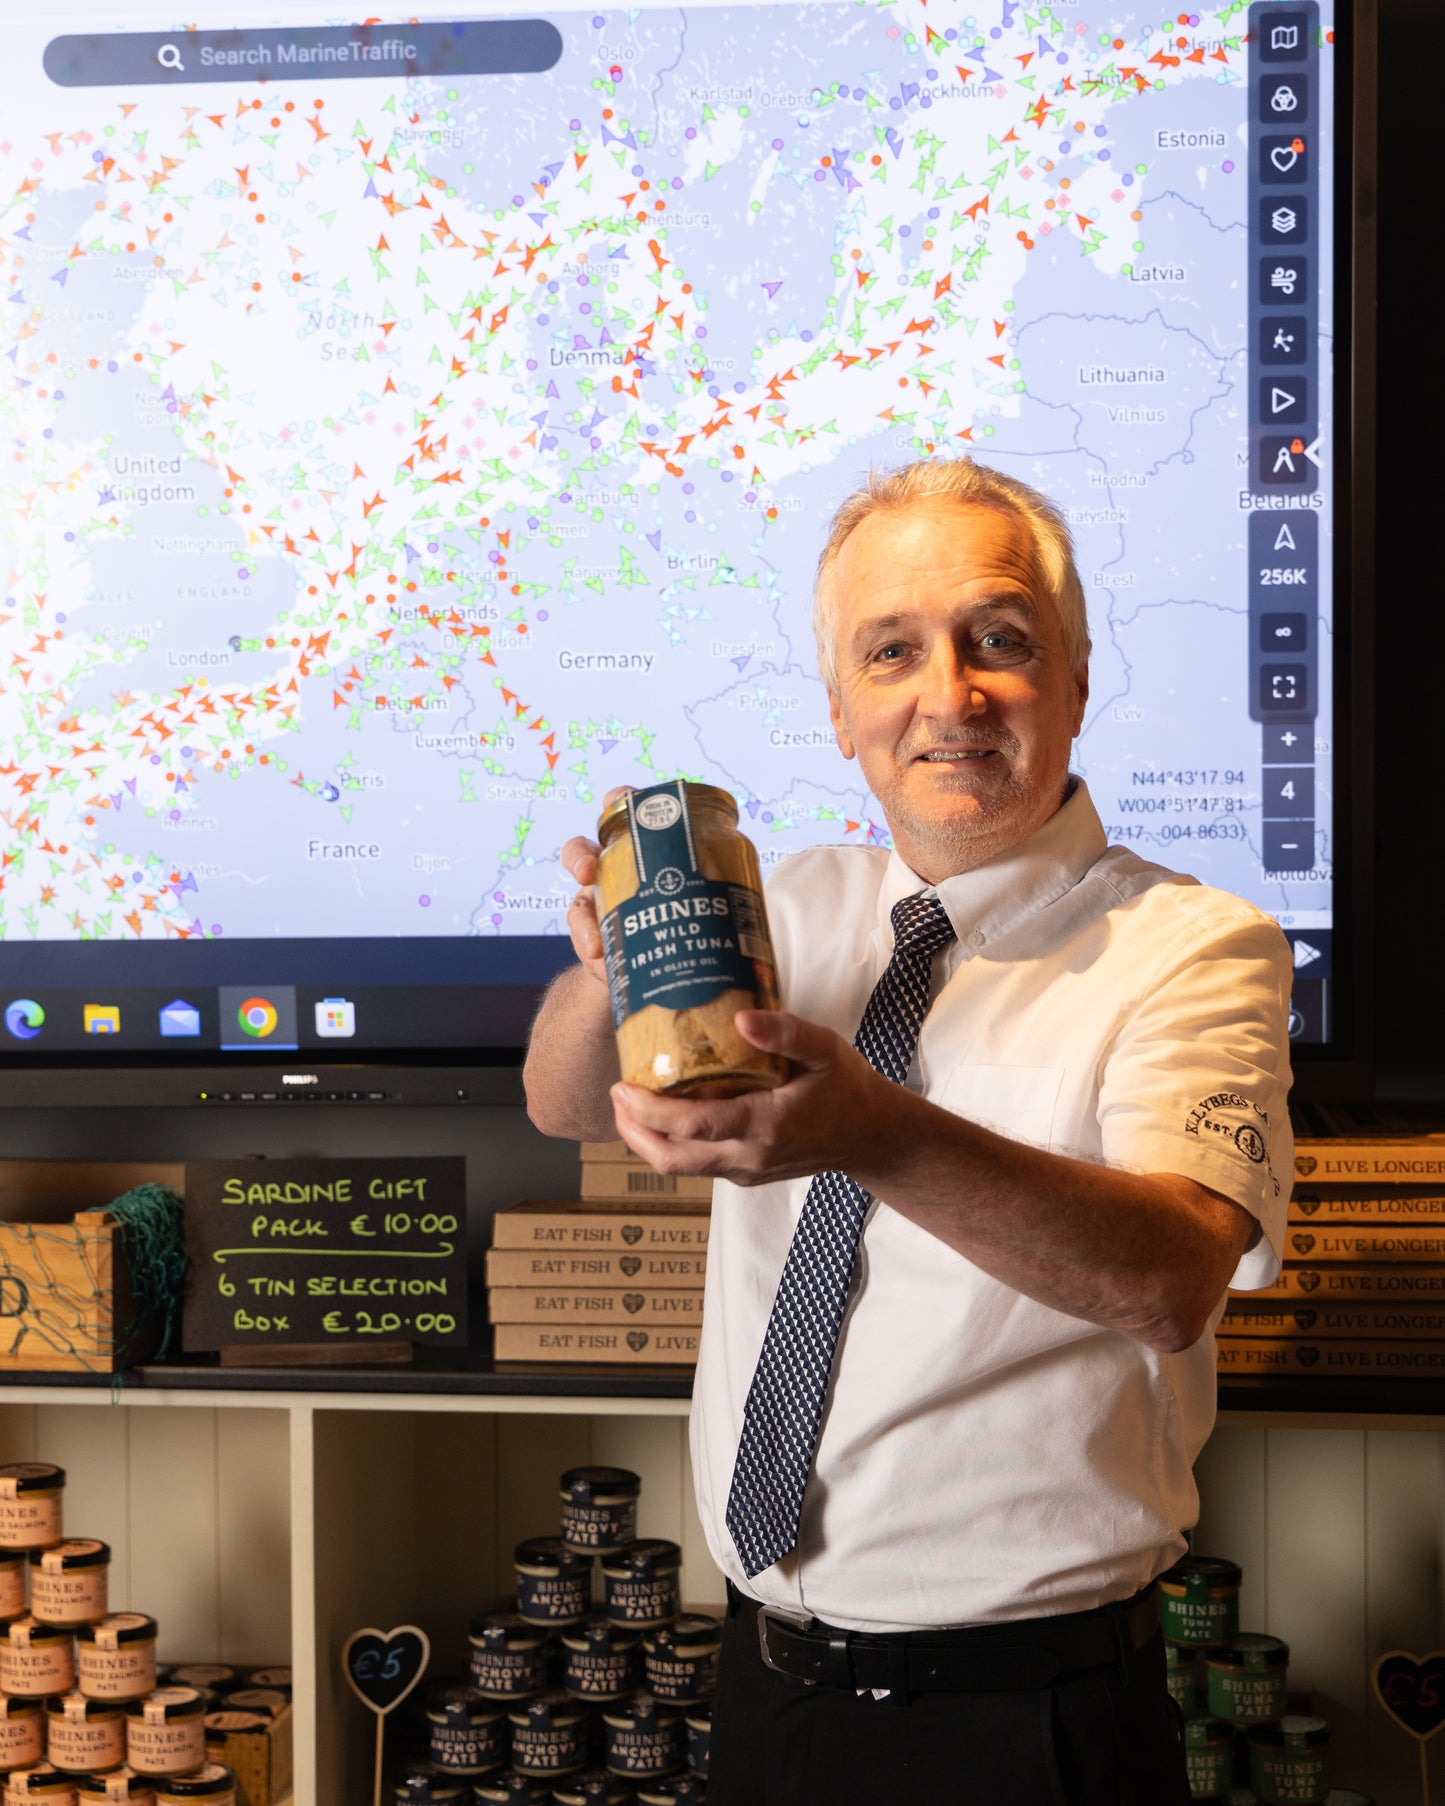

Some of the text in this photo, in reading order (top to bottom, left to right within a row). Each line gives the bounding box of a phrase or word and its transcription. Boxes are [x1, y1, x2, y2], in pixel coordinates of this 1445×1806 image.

[200, 40, 417, 66] Search MarineTraffic
[598, 46, 633, 61] Oslo
[690, 88, 752, 100] Karlstad
[1158, 131, 1225, 148] Estonia
[114, 267, 183, 280] Aberdeen
[562, 262, 619, 277] Aalborg
[1130, 266, 1184, 282] Latvia
[550, 350, 646, 367] Denmak
[1079, 367, 1165, 384] Lithuania
[1109, 408, 1165, 423] Vilnius
[114, 456, 181, 475] United
[1091, 474, 1147, 487] Hrodna
[153, 538, 238, 554] Nottingham
[1095, 573, 1134, 587] Brest
[1260, 568, 1307, 585] 256K
[176, 587, 253, 599] ENGLAND
[712, 643, 774, 657] Dresden
[169, 651, 229, 667] London
[559, 651, 654, 672] Germany
[1114, 707, 1143, 720] Lviv
[341, 772, 384, 788] Paris
[1281, 781, 1296, 800] 4
[309, 841, 380, 858] France
[171, 863, 222, 875] Nantes
[413, 855, 450, 871] Dijon
[623, 897, 729, 937] SHINES
[655, 923, 701, 941] WILD
[631, 937, 735, 969] IRISH TUNA
[664, 958, 697, 973] OLIVE
[700, 957, 719, 966] OIL
[1204, 1119, 1232, 1137] EST.
[1325, 1160, 1368, 1174] LIVE
[221, 1178, 427, 1205] SARDINE GIFT
[1329, 1200, 1371, 1213] LIVE
[252, 1215, 328, 1238] PACK
[534, 1228, 567, 1241] EAT
[572, 1229, 612, 1241] FISH
[650, 1230, 691, 1243] LIVE
[1323, 1238, 1445, 1253] LIVE LONGER
[531, 1260, 690, 1274] EAT FISH LIVE
[218, 1273, 447, 1297] 6 TIN SELECTION
[1328, 1276, 1370, 1290] LIVE
[535, 1297, 693, 1312] EAT FISH LIVE
[1243, 1313, 1284, 1326] FISH
[539, 1334, 697, 1350] EAT FISH LIVE
[1245, 1350, 1287, 1364] FISH
[8, 1519, 46, 1529] SALMON
[566, 1530, 599, 1545] PATE
[54, 1595, 93, 1605] SALMON
[44, 1606, 63, 1615] PATE
[626, 1606, 662, 1619] PATE
[1168, 1601, 1227, 1616] SHINES
[1181, 1617, 1212, 1627] TUNA
[1183, 1628, 1211, 1639] PATE
[81, 1656, 139, 1669] SHINES
[22, 1668, 60, 1678] SALMON
[109, 1669, 146, 1680] SALMON
[11, 1680, 31, 1689] PATE
[97, 1683, 118, 1692] PATE
[479, 1677, 513, 1691] PATE
[581, 1679, 618, 1692] PATE
[653, 1684, 678, 1697] PATE
[1222, 1679, 1281, 1693] SHINES
[1233, 1693, 1273, 1705] TUNA
[1236, 1705, 1272, 1716] PATE
[51, 1729, 107, 1742] SHINES
[130, 1731, 186, 1745] SHINES
[432, 1727, 488, 1742] SHINES
[514, 1729, 569, 1744] SHINES
[78, 1742, 114, 1753] SALMON
[157, 1743, 194, 1755] SALMON
[64, 1755, 86, 1764] PATE
[145, 1757, 166, 1767] PATE
[442, 1752, 478, 1765] PATE
[523, 1754, 560, 1767] PATE
[626, 1757, 664, 1769] PATE
[1264, 1761, 1323, 1775] SHINES
[1189, 1780, 1216, 1792] ATE
[1275, 1775, 1316, 1788] TUNA
[1277, 1787, 1315, 1799] PATE
